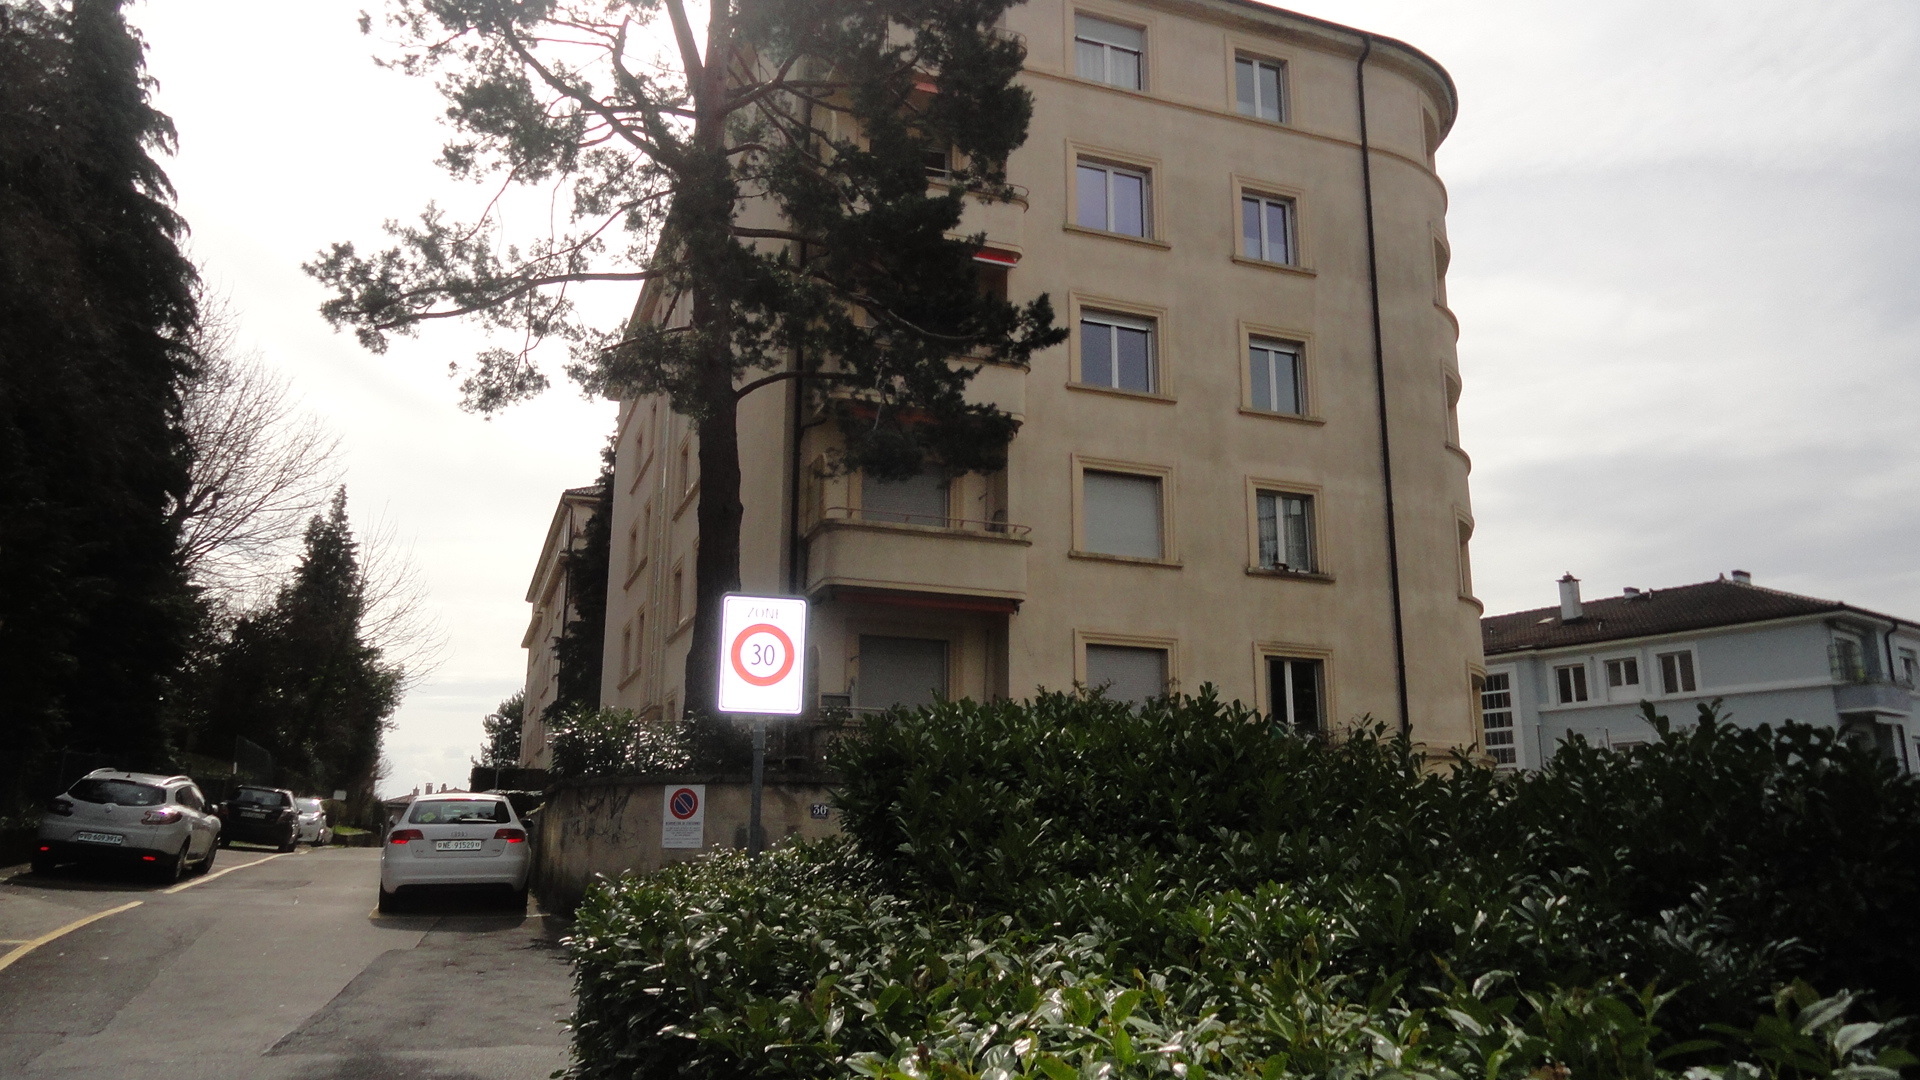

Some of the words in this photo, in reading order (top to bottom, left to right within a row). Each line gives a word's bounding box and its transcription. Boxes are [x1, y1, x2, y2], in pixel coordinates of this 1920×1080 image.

[751, 643, 775, 666] 30
[442, 841, 452, 849] NE
[454, 841, 475, 849] 91529
